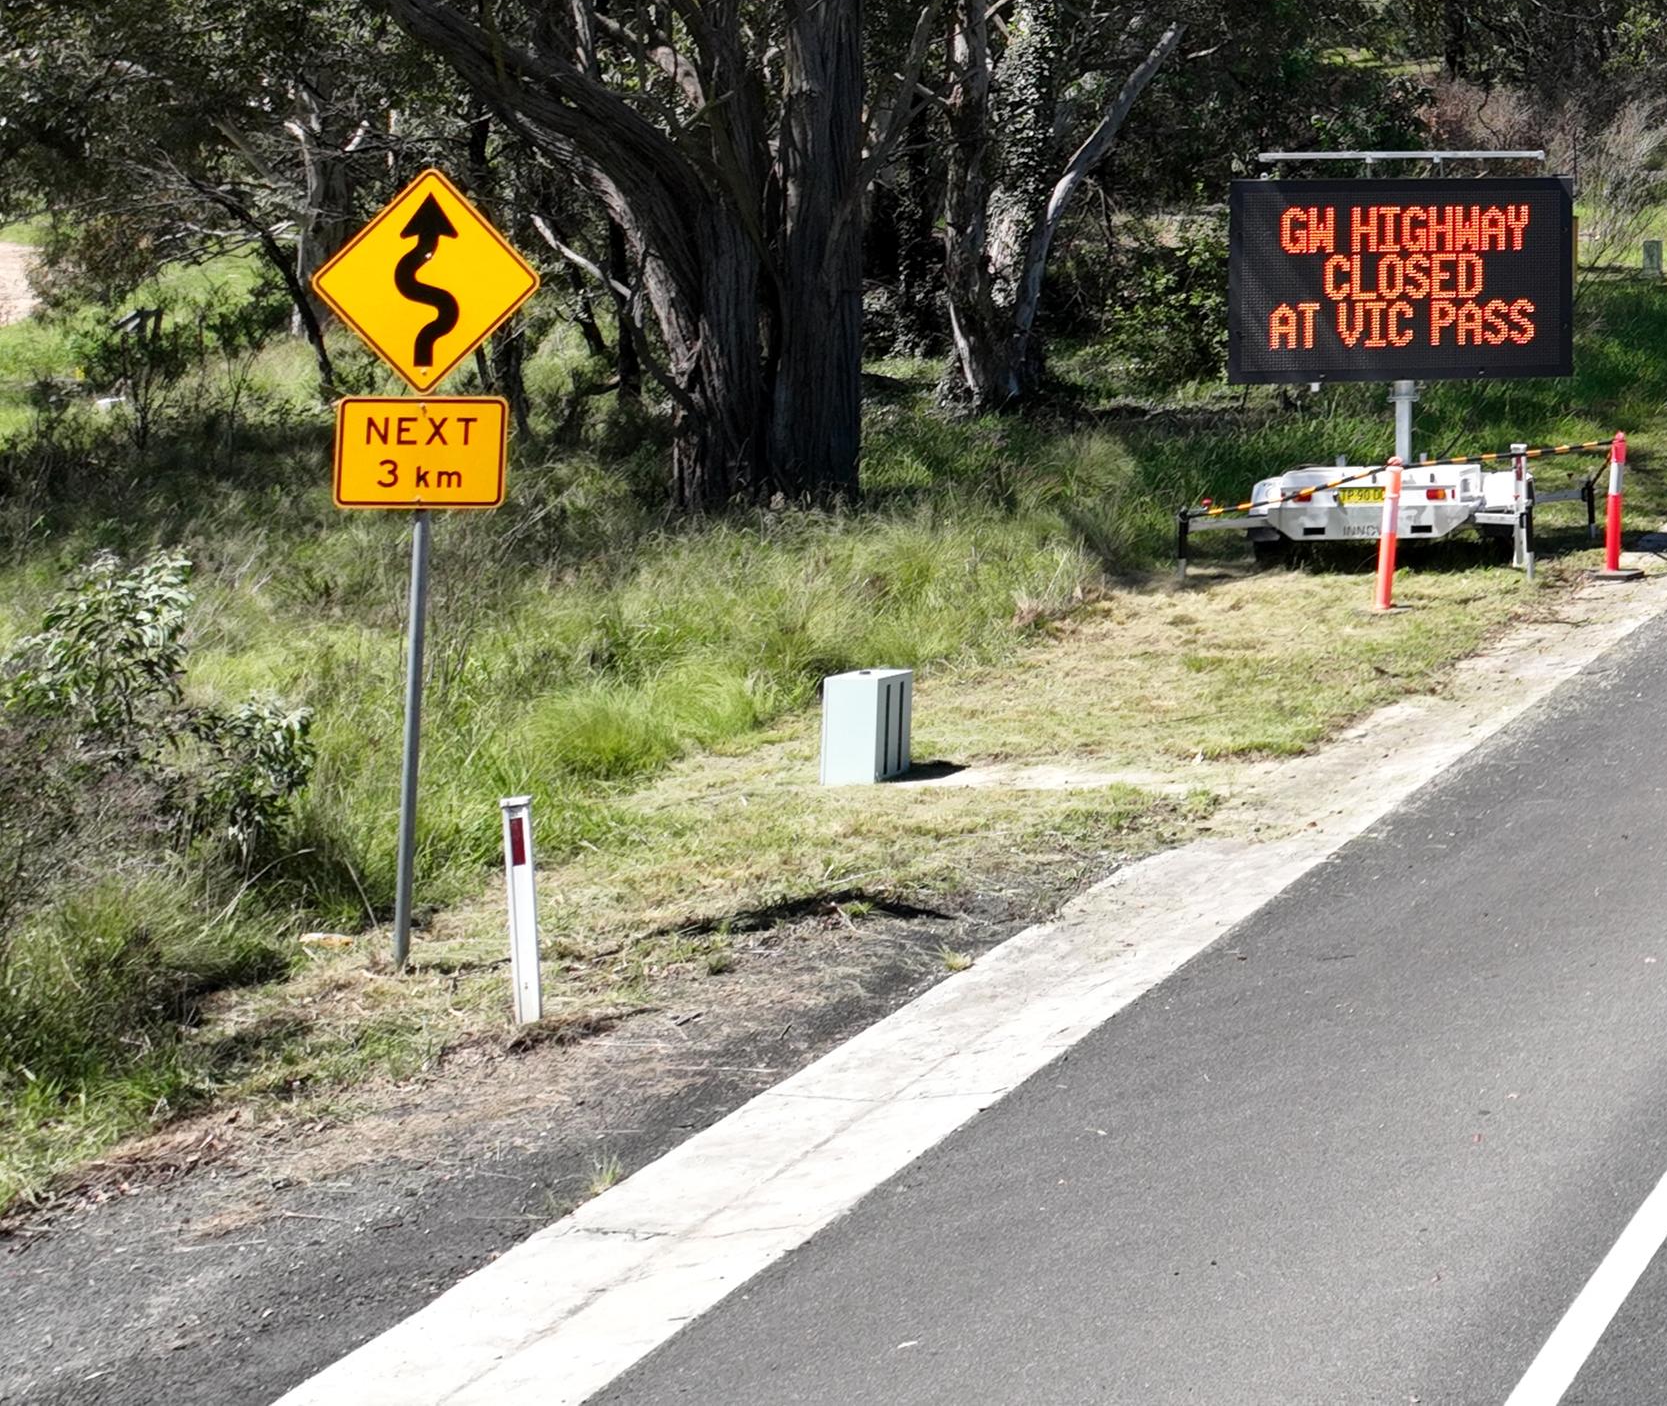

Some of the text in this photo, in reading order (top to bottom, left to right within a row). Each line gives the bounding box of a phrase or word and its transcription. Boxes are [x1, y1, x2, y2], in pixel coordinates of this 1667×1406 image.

[1280, 205, 1530, 254] GW HIGHWAY
[1323, 253, 1484, 301] CLOSED
[1269, 298, 1536, 350] AT VIC PASS
[365, 416, 478, 446] NEXT
[376, 459, 463, 489] 3 km
